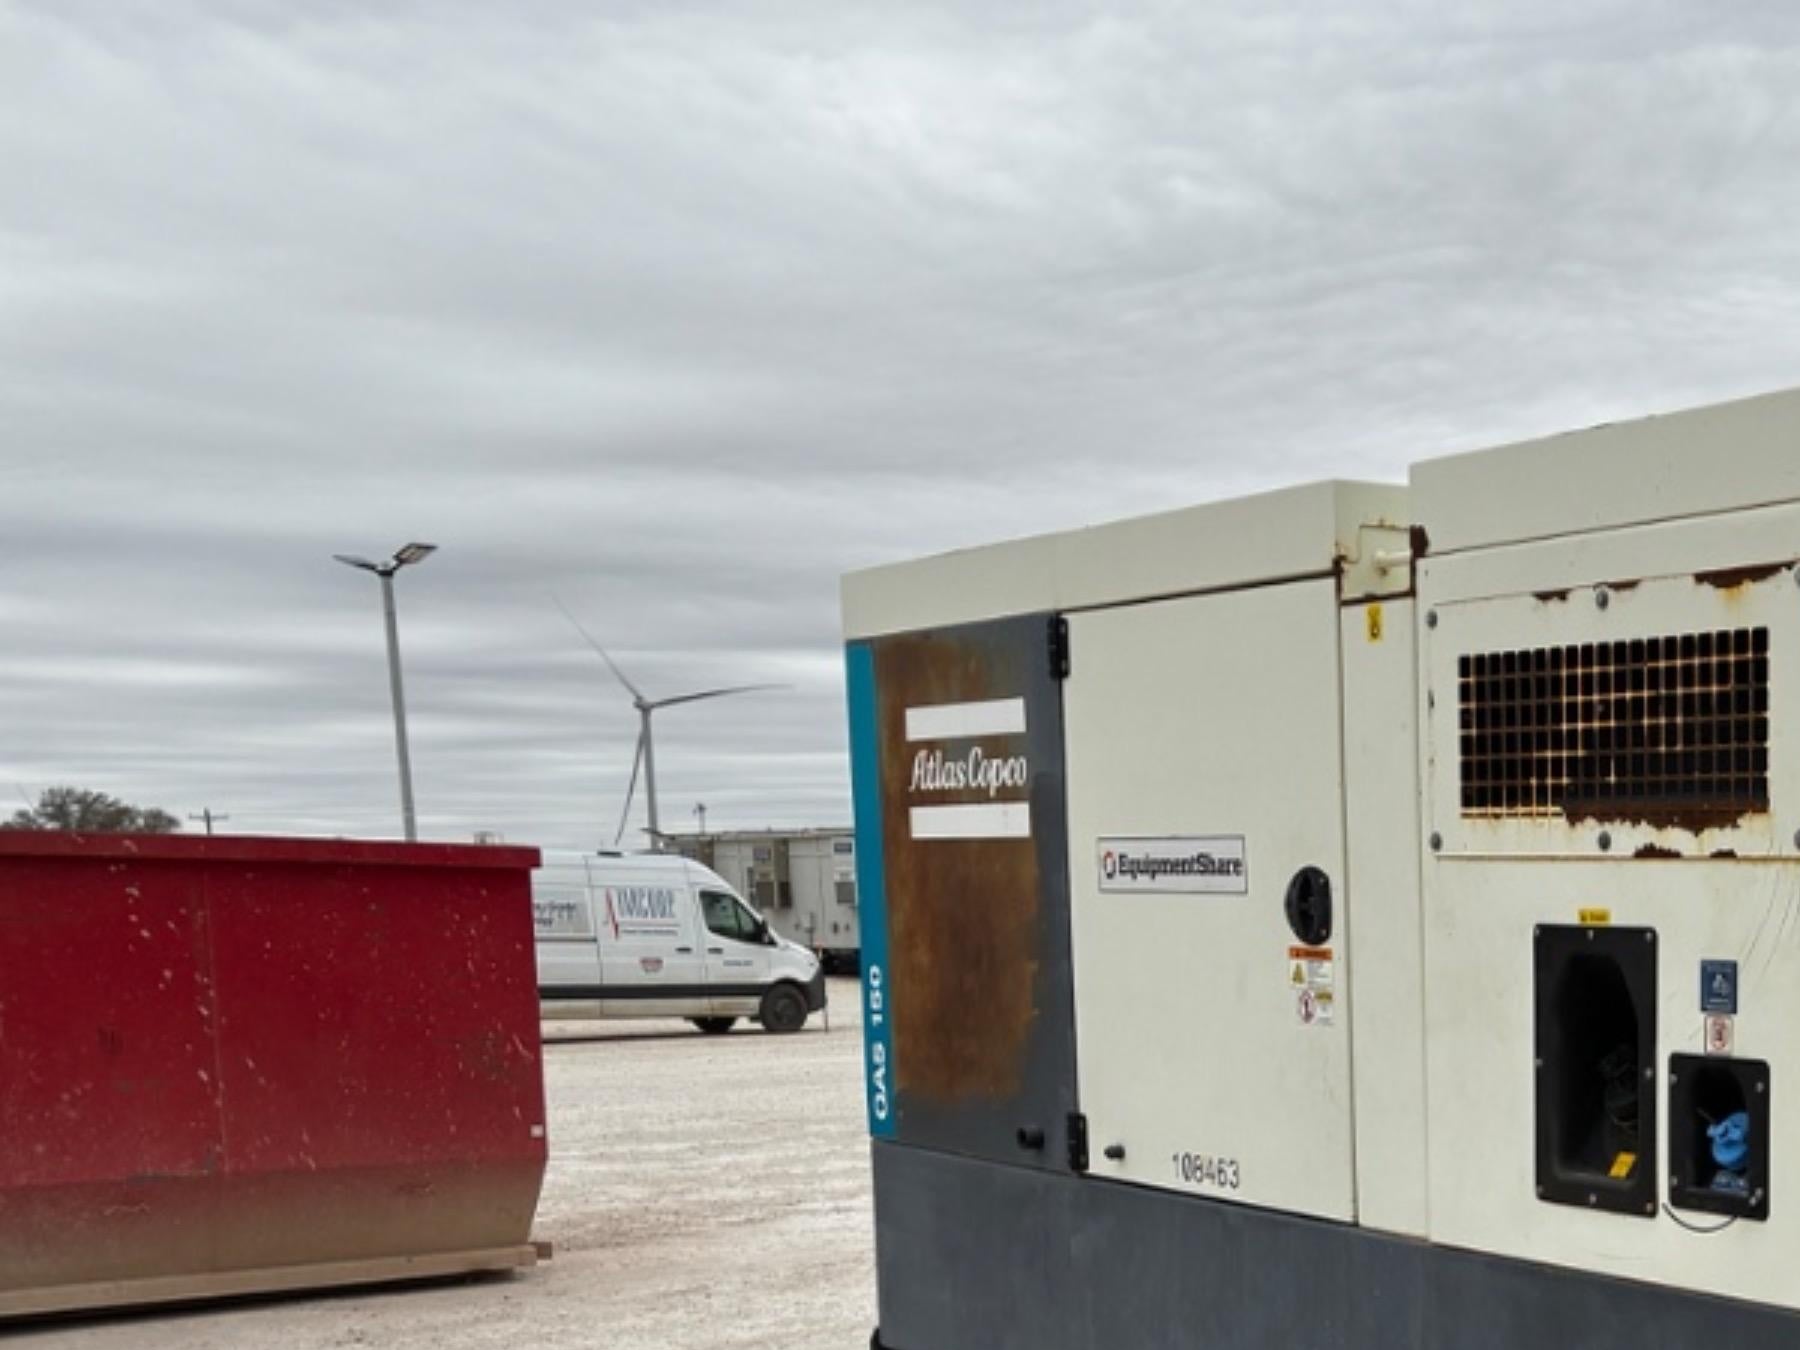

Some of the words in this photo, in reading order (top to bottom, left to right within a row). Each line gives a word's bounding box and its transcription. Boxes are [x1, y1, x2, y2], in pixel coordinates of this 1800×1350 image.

[908, 749, 967, 790] Atlas
[968, 746, 1027, 798] Copco
[1118, 851, 1243, 881] EquipmentShare
[1171, 1151, 1240, 1189] 108463
